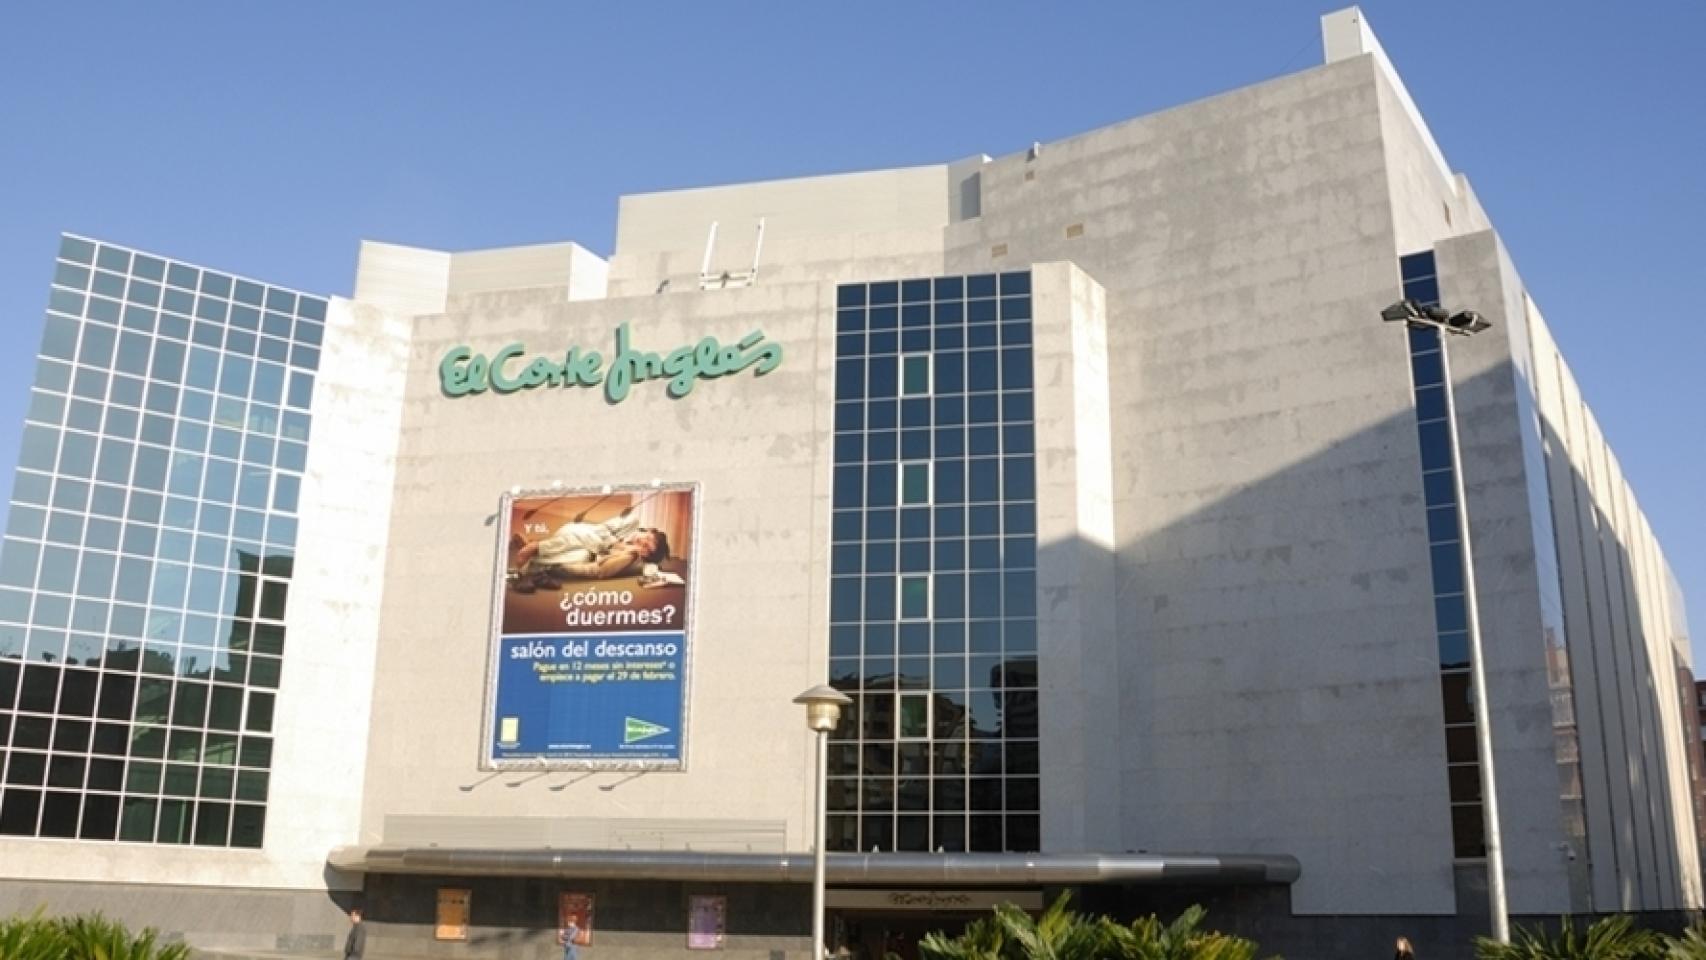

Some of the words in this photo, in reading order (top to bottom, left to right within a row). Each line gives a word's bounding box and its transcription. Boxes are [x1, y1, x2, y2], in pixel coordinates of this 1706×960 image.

[441, 346, 488, 398] El
[489, 343, 602, 394] Corte
[604, 321, 783, 405] Inglés
[560, 587, 633, 610] ¿cómo
[566, 604, 676, 626] duermes?
[511, 641, 555, 659] salón
[562, 640, 588, 658] del
[595, 640, 677, 658] descanso
